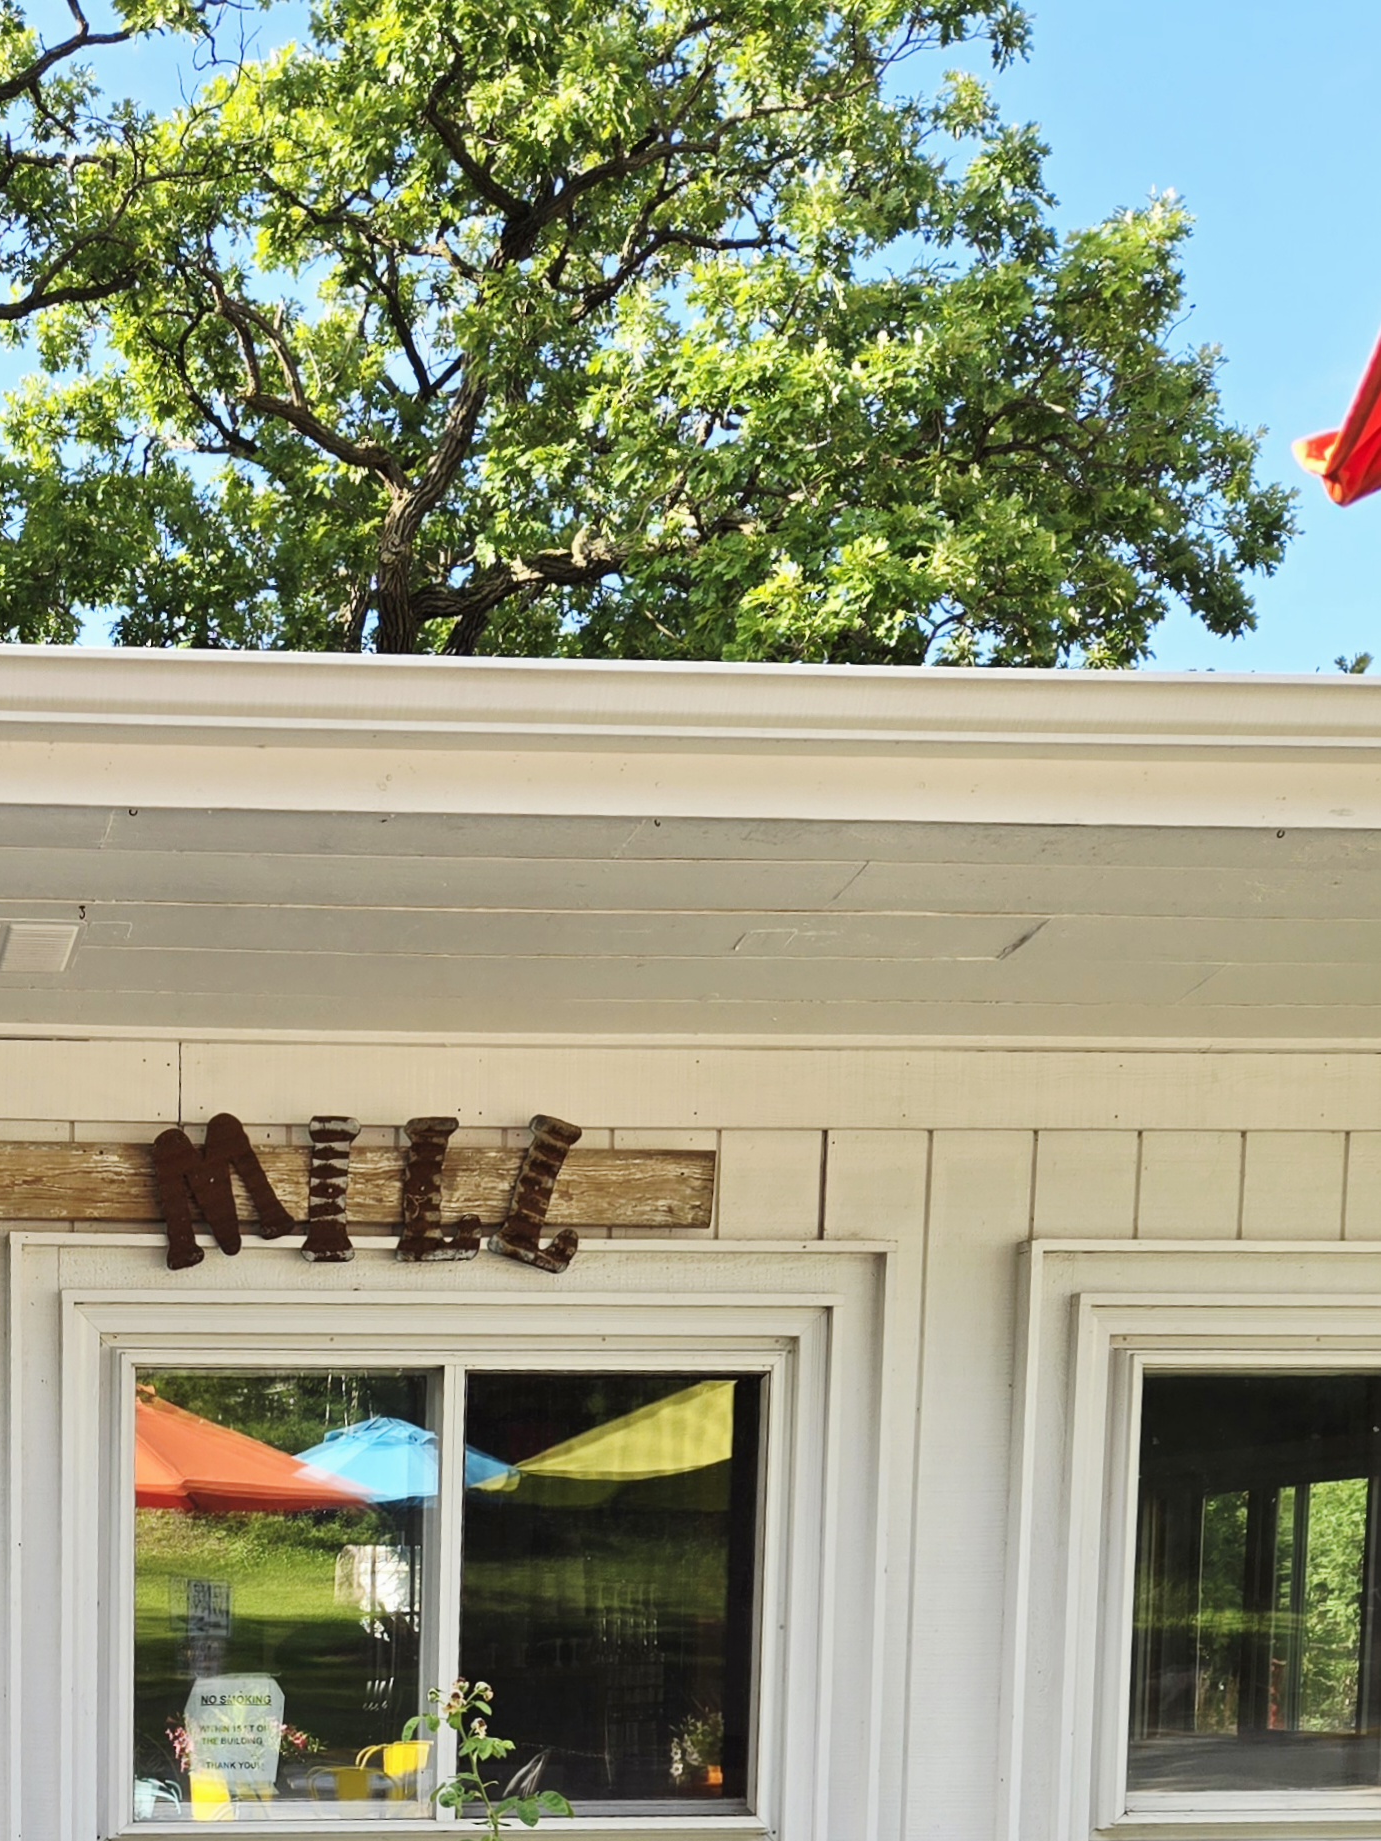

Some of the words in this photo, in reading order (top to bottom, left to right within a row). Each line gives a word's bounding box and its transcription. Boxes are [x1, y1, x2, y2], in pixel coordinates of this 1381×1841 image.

[154, 1112, 582, 1274] MILL
[201, 1695, 217, 1704] NO
[219, 1695, 272, 1704] SMOKING
[220, 1737, 263, 1745] BUILDING
[206, 1761, 236, 1769] THANK
